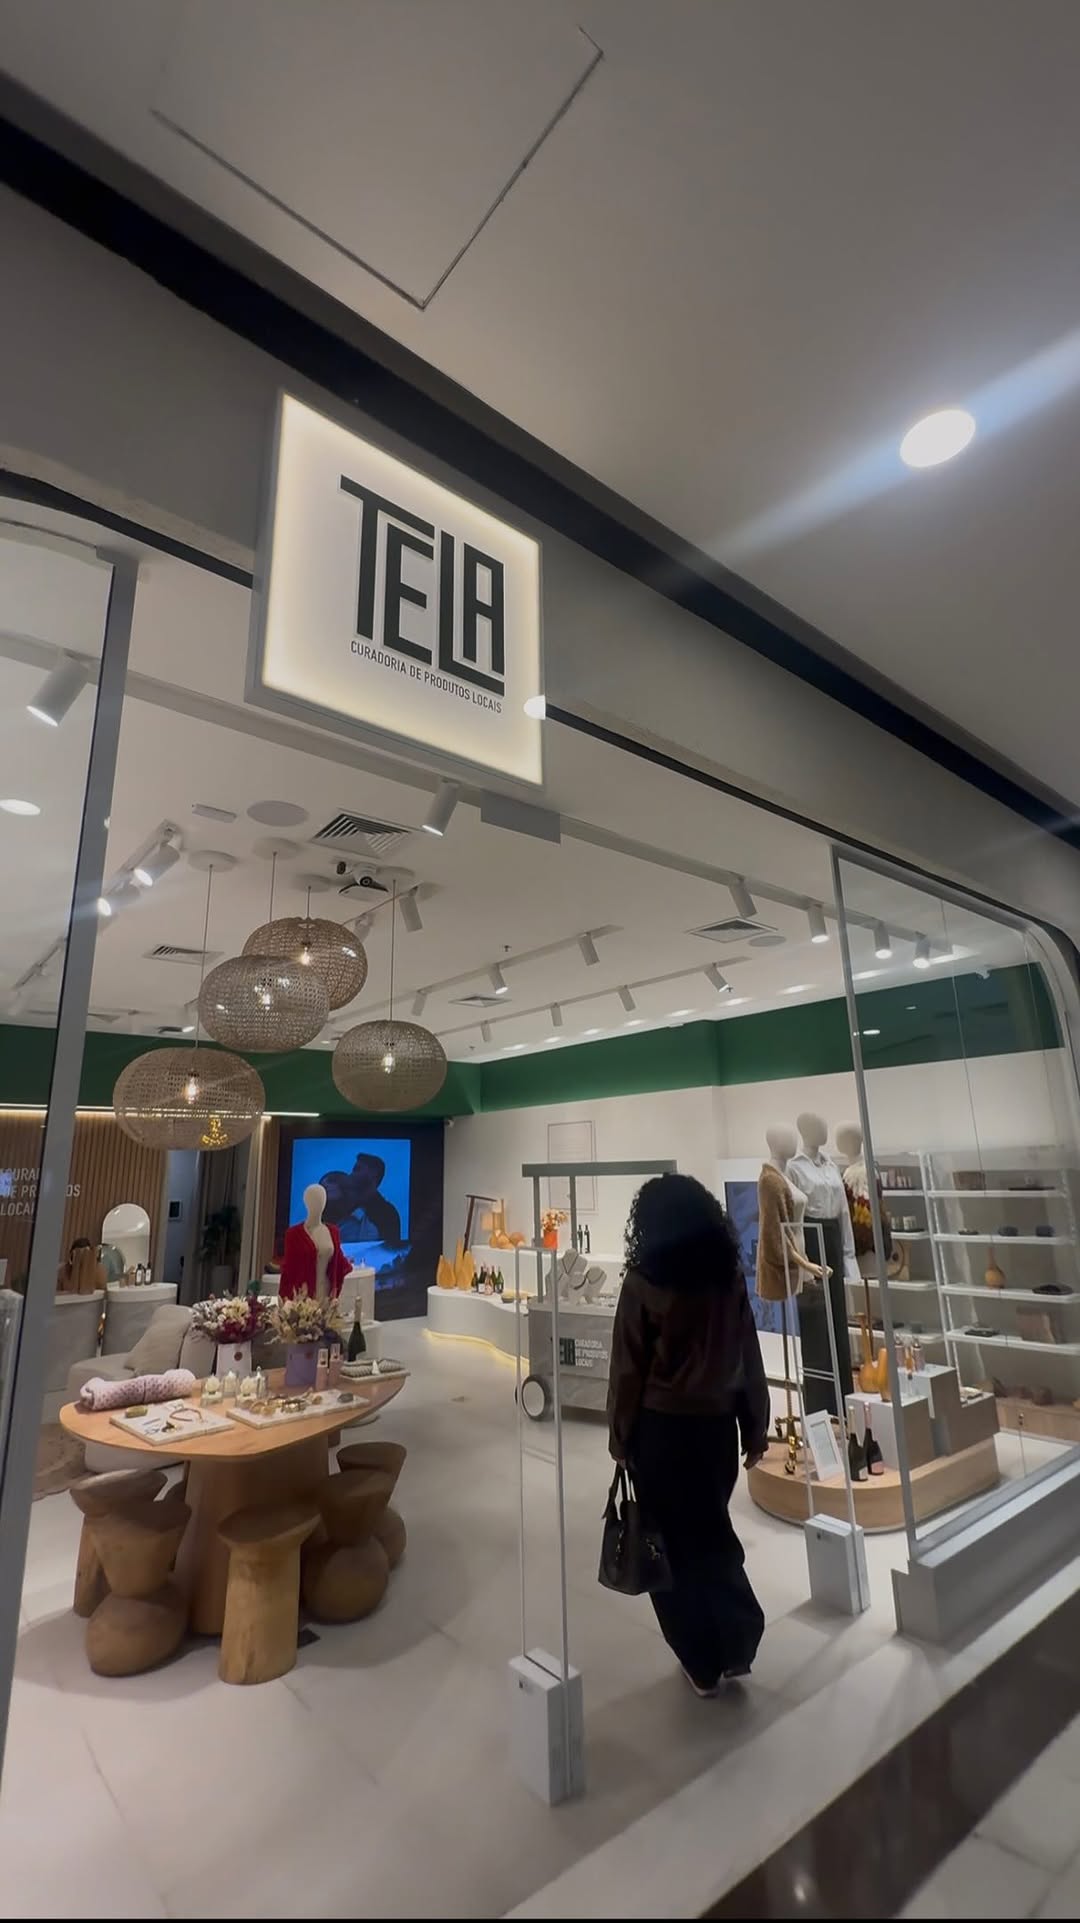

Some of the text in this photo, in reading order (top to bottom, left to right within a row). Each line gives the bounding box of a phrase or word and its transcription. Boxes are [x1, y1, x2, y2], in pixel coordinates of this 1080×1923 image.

[340, 474, 505, 697] TELA
[351, 640, 503, 714] CURADORIA DE PRODUTOS LOCAIS
[0, 1202, 35, 1217] LOCAI
